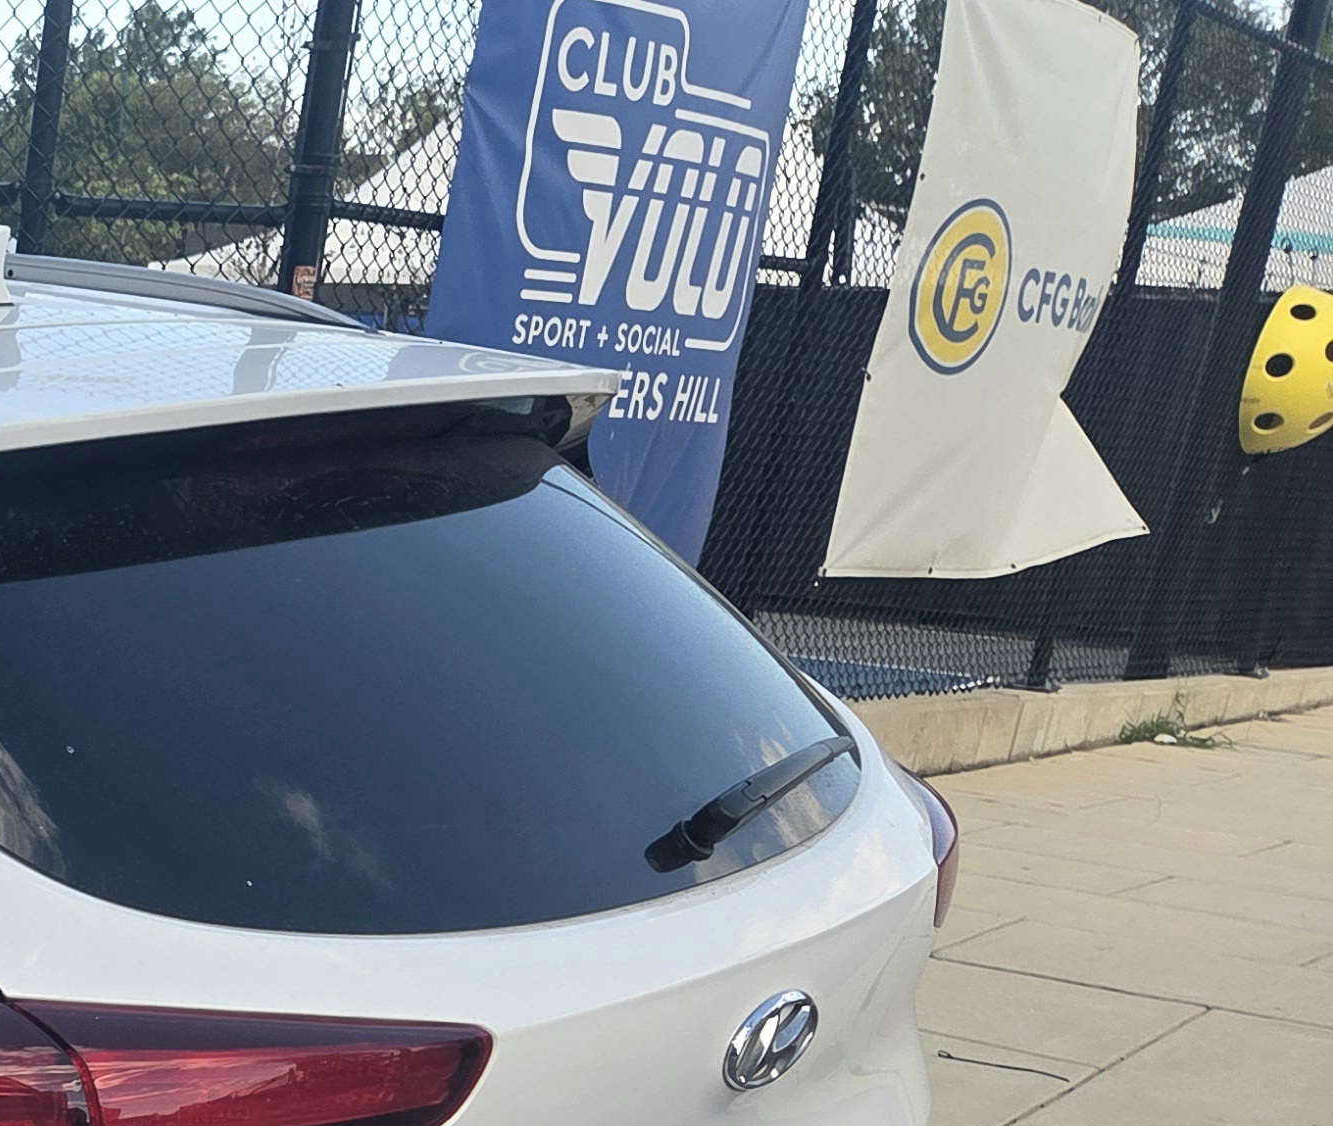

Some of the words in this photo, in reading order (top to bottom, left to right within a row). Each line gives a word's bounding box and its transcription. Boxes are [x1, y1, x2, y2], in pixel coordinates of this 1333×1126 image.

[557, 26, 678, 107] CLUB
[1017, 267, 1072, 328] CFG
[512, 313, 592, 349] SPORT
[614, 322, 680, 357] SOCIAL
[669, 375, 721, 424] HILL
